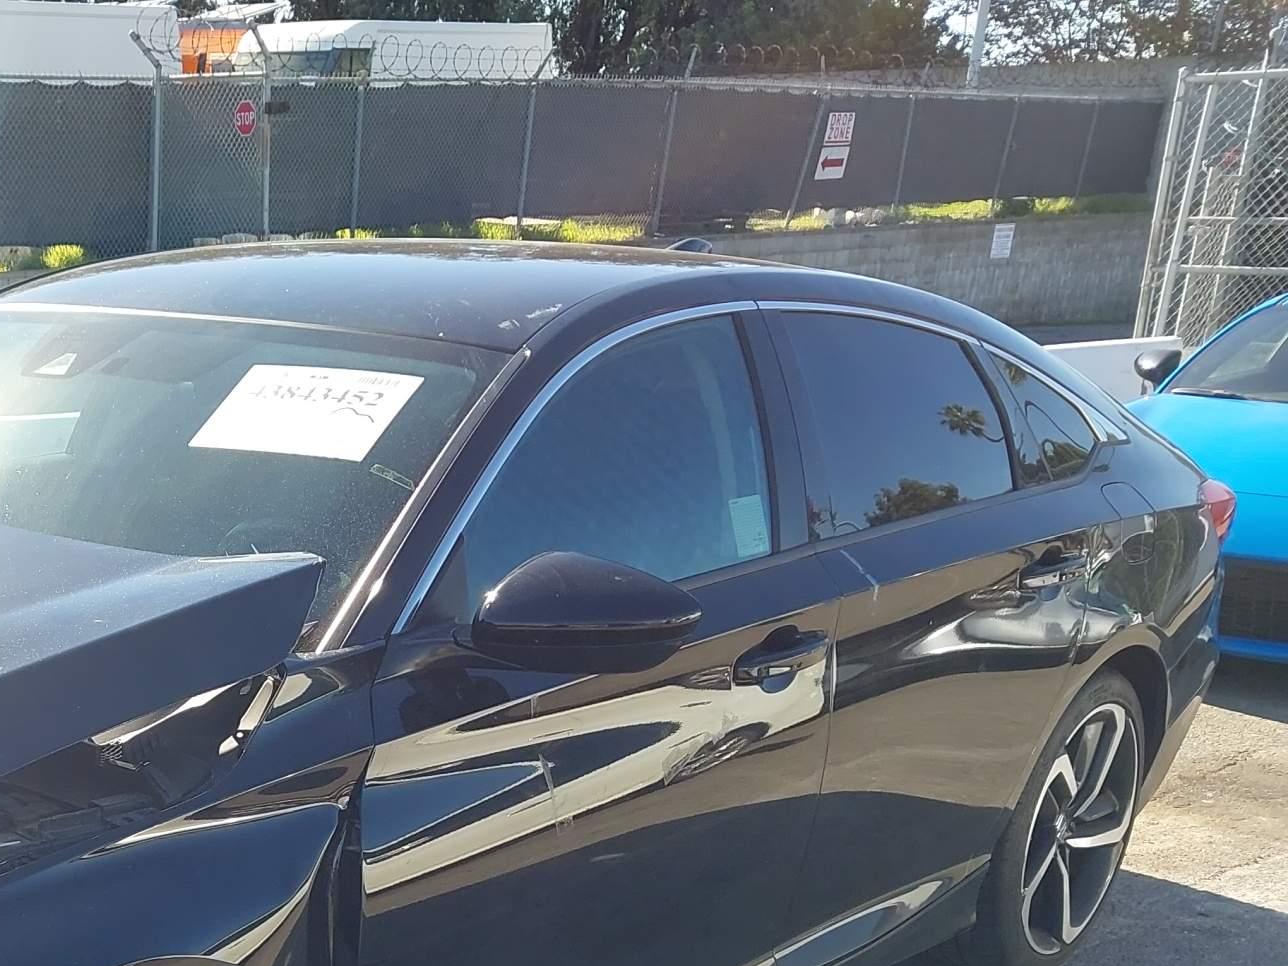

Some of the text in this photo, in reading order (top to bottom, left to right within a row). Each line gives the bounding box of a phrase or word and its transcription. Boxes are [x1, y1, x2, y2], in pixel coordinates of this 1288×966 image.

[236, 112, 255, 126] STOP
[830, 113, 854, 126] DROP
[827, 127, 851, 140] ZONE
